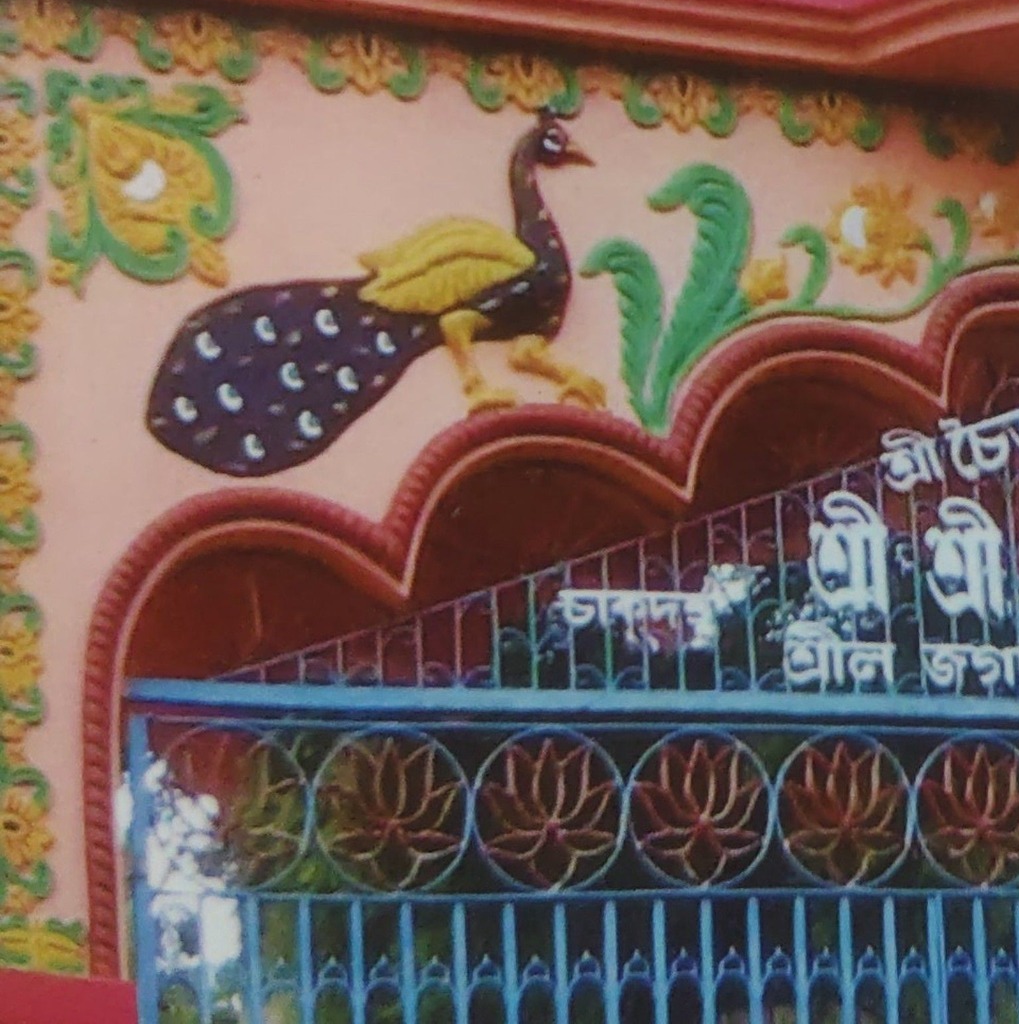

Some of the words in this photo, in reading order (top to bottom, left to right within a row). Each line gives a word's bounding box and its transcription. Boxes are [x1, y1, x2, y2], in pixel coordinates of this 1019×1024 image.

[880, 428, 946, 492] শ্রী
[808, 490, 889, 614] শ্রী
[925, 497, 1002, 619] শ্রী
[783, 621, 896, 689] শ্রীল
